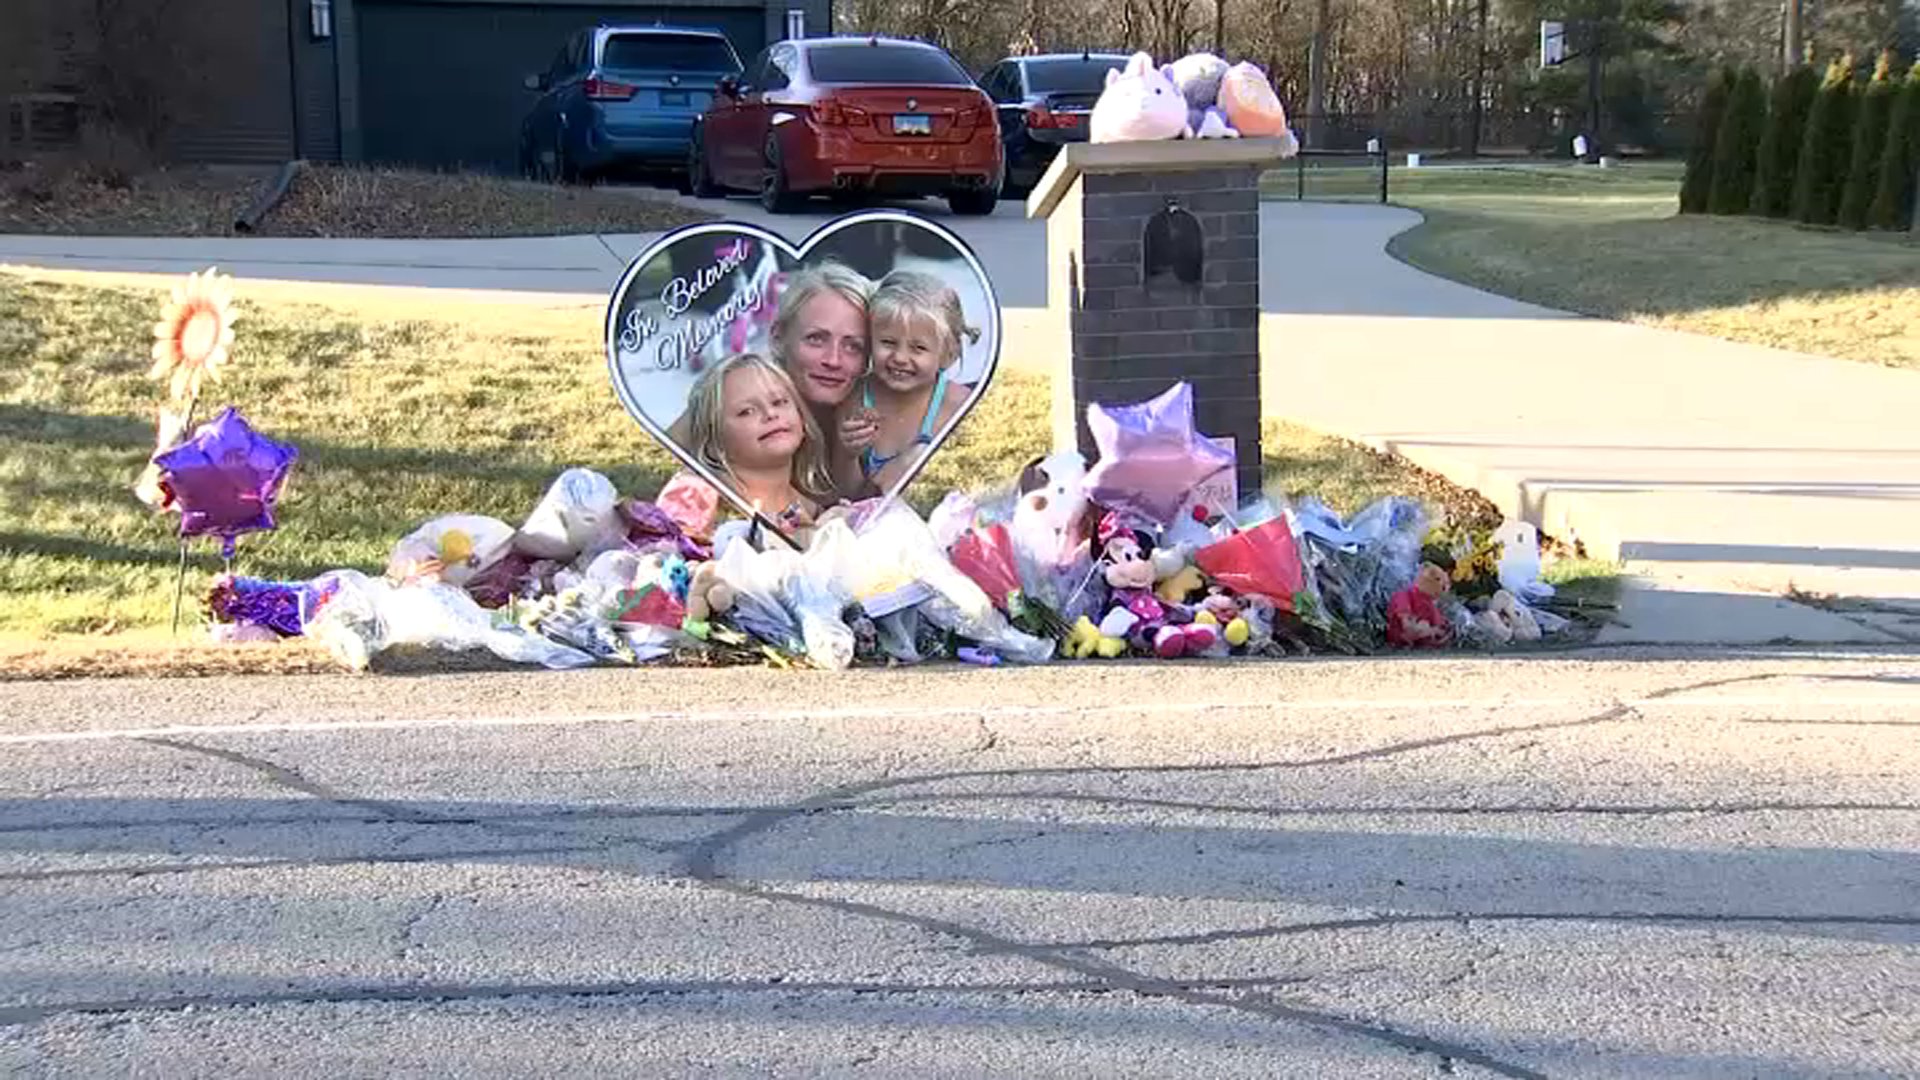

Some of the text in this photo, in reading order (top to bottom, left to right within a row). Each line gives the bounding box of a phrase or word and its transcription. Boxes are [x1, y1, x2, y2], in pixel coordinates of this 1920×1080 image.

[620, 239, 748, 350] In Beloved
[656, 281, 762, 369] Memory
